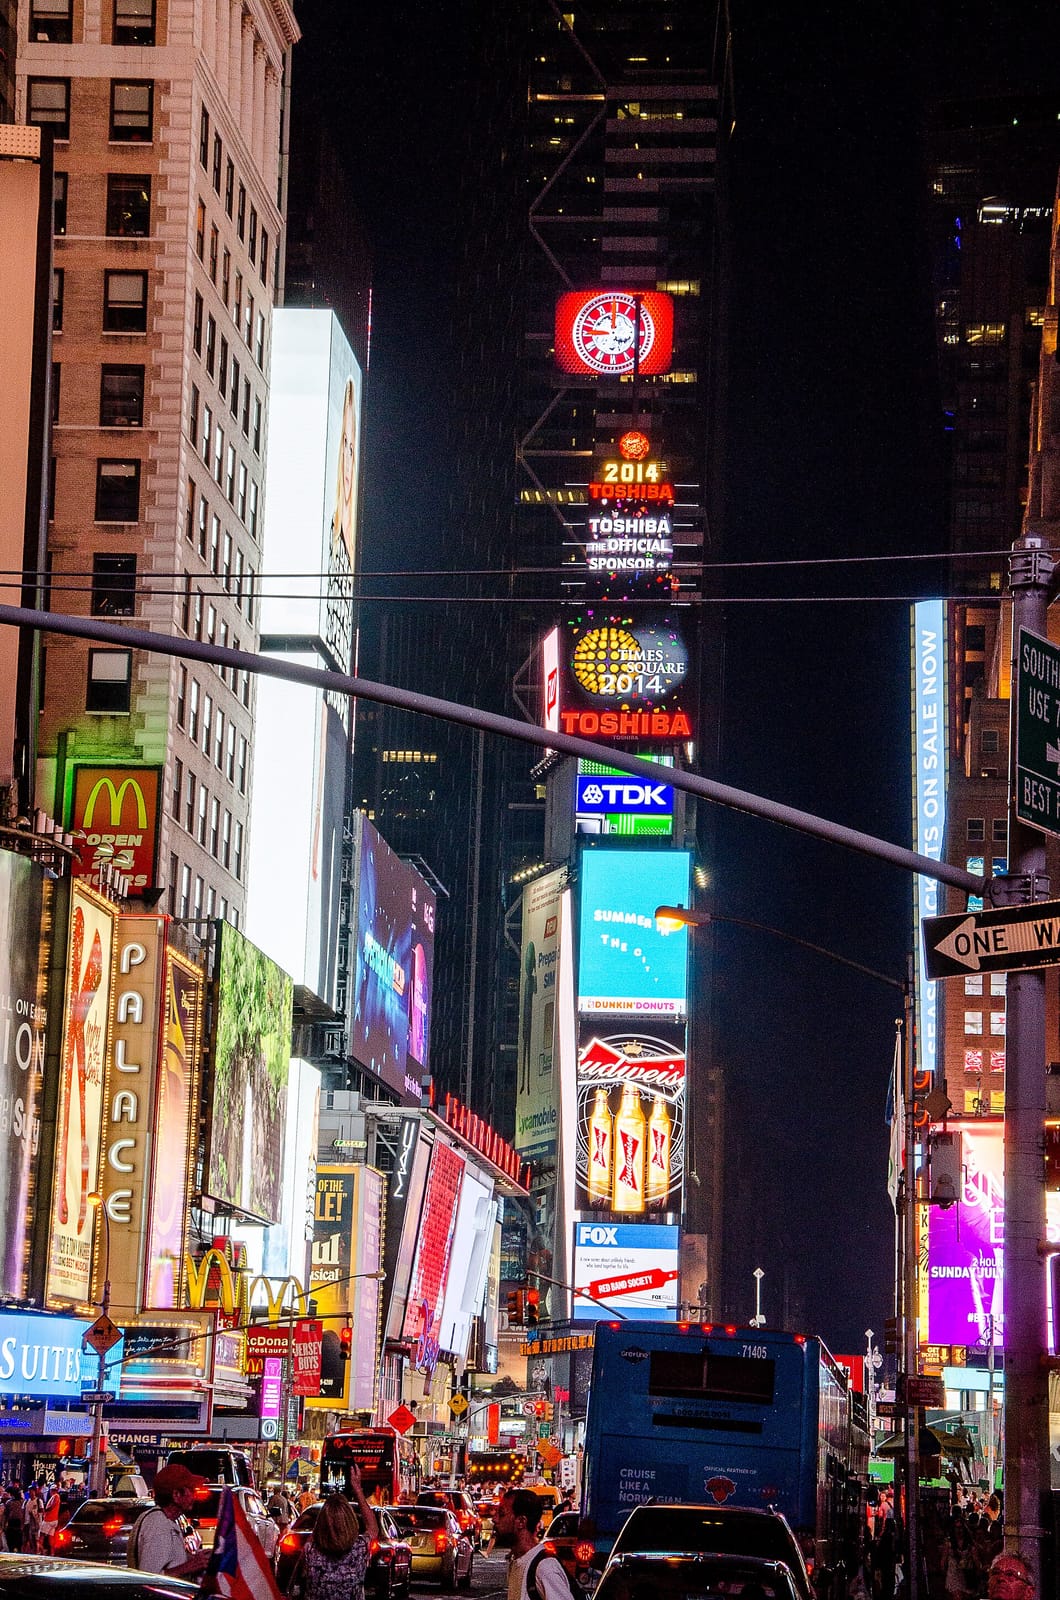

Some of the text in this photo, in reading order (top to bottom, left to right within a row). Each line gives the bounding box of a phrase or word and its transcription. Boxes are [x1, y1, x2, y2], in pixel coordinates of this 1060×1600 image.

[604, 464, 660, 483] 2014
[589, 485, 673, 499] TOSHIBA
[588, 518, 671, 533] TOSHIBA
[591, 539, 673, 552] THE OFFICIAL
[589, 557, 654, 570] SPONSOR
[617, 650, 664, 661] TIMES
[922, 629, 938, 694] NOW
[626, 662, 686, 674] SQUARE
[1022, 643, 1060, 691] SOUTH
[1029, 686, 1050, 724] USE
[561, 712, 692, 736] TOSHIBA
[923, 701, 938, 769] SALE
[602, 784, 666, 805] TDK
[923, 780, 938, 814] ON
[1024, 776, 1051, 816] BEST
[86, 834, 142, 846] OPEN
[78, 874, 148, 887] HORS
[593, 910, 652, 929] SUMMER
[600, 934, 628, 952] THE
[955, 928, 1008, 956] ONE
[633, 948, 659, 982] CITY
[15, 999, 29, 1016] ON
[595, 1000, 675, 1011] DUNKIN' DONUTS
[107, 943, 147, 1224] PALACE
[318, 1179, 344, 1192] OF THE
[580, 1226, 618, 1246] FOX
[972, 1258, 979, 1267] 2
[931, 1266, 975, 1278] SUNDAY
[598, 1275, 653, 1294] RED BAND SOCIETY
[294, 1341, 323, 1357] JERSEY
[742, 1345, 768, 1359] 71405
[0, 1338, 81, 1382] SUITES
[298, 1356, 319, 1370] BOYS
[107, 1434, 157, 1444] XCHANGE
[619, 1468, 656, 1479] CRUISE
[619, 1481, 650, 1491] LIKE A
[618, 1492, 682, 1504] NORWGIAN
